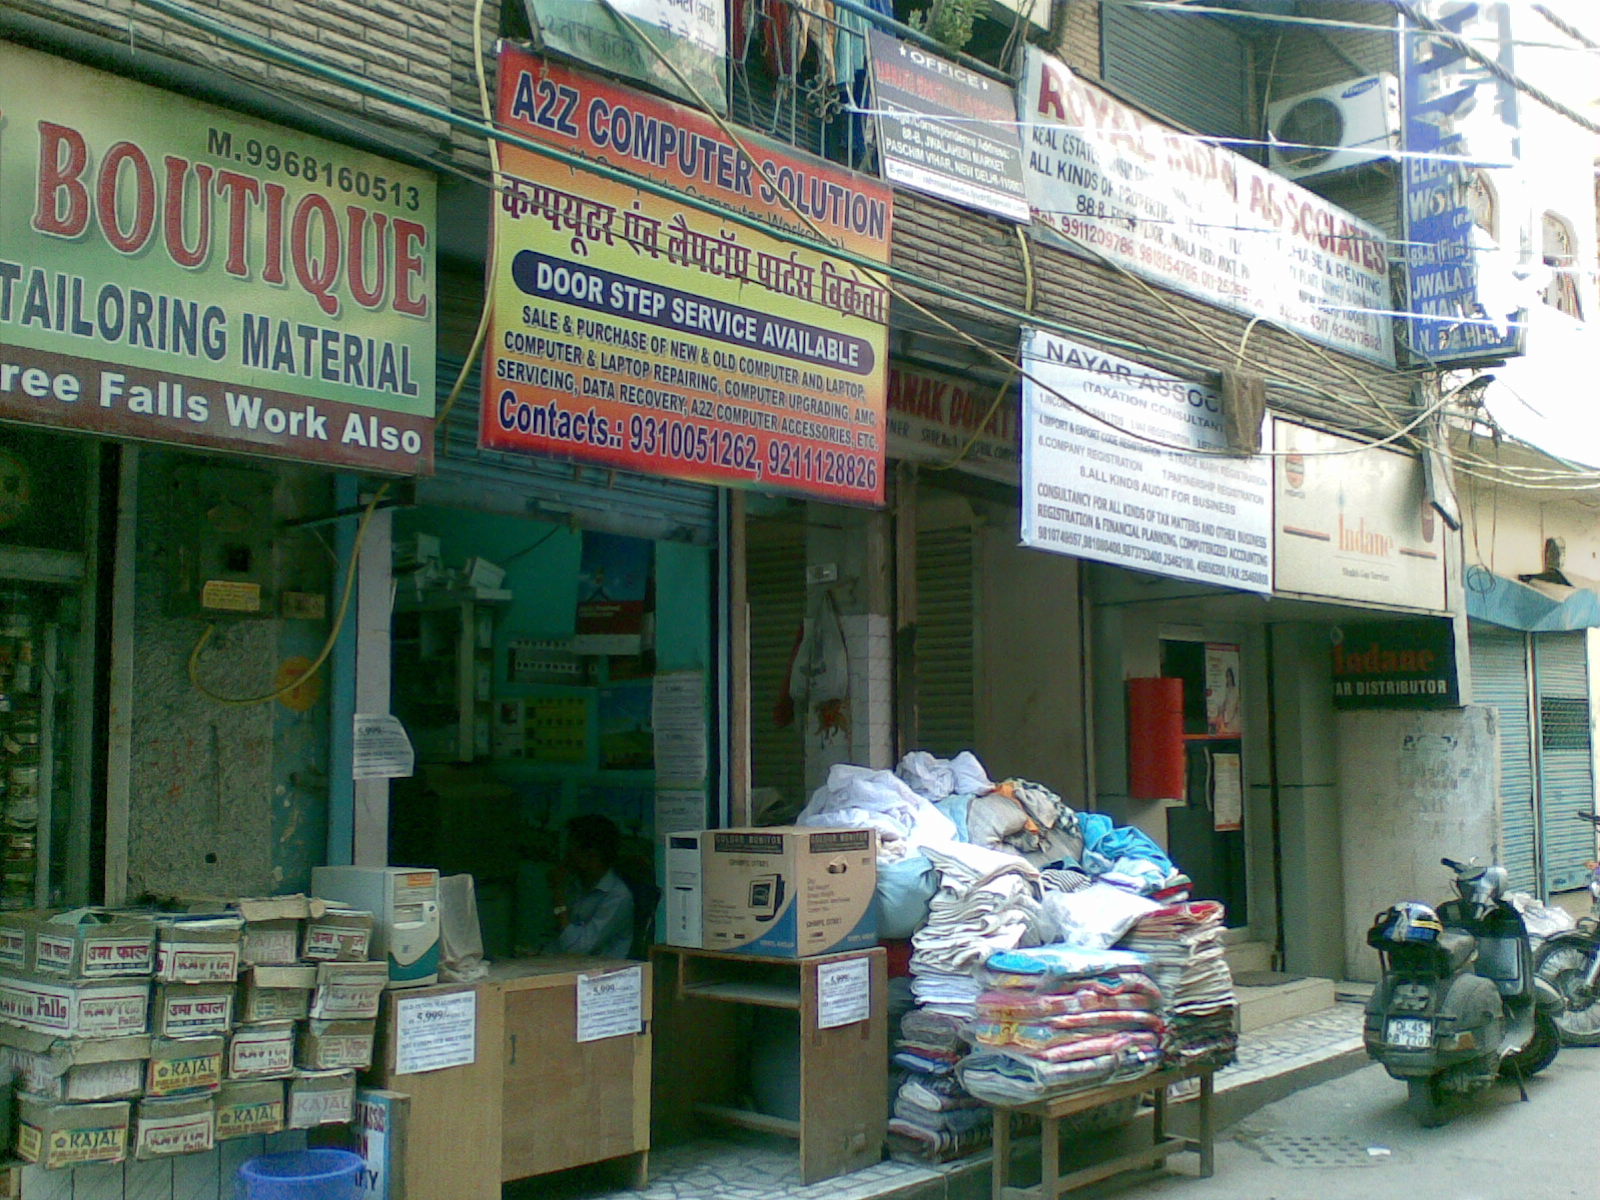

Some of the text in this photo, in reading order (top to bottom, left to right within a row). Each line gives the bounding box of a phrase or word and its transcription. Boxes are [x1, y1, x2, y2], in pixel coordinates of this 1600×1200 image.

[911, 51, 979, 89] OFFICE
[208, 127, 421, 211] M.9968160513
[511, 70, 579, 138] A2Z
[588, 97, 753, 197] COMPUTER
[760, 160, 886, 242] SOLUTION
[1030, 151, 1053, 177] ALL
[1058, 160, 1098, 191] KINDS
[32, 119, 429, 317] BOUTIQUE
[1336, 266, 1381, 296] RENTING
[1412, 267, 1462, 300] JWALA
[0, 261, 420, 397] TAILORING MATERIAL
[537, 262, 860, 368] DOOR STEP SERVICE AVAILABLE
[523, 305, 560, 331] SALE
[562, 314, 573, 335] &
[577, 318, 648, 351] PURCHASE
[651, 335, 667, 355] OF
[671, 340, 698, 362] NEW
[700, 347, 710, 365] &
[713, 350, 736, 371] OLD
[740, 356, 799, 386] COMPUTER
[802, 371, 823, 391] AND
[497, 358, 579, 397] SERVICING,
[583, 376, 615, 400] DATA
[620, 383, 689, 416] RECOVERY,
[691, 398, 714, 419] A2Z
[717, 404, 778, 432] COMPUTER
[504, 331, 583, 366] COMPUTER
[586, 349, 597, 368] &
[601, 352, 650, 379] LAPTOP
[654, 363, 722, 397] REPAIRING,
[725, 379, 786, 407] COMPUTER
[854, 408, 876, 426] AMC
[1047, 340, 1223, 414] NAYAR ASSOC
[1083, 381, 1148, 410] (TAXATION
[0, 362, 422, 455] ree Falls Work Also
[630, 414, 764, 481] 9310051262,
[769, 440, 877, 492] 9211128826
[1087, 445, 1143, 473] REGISTRATION
[1038, 482, 1092, 508] CONSULTANCY
[1093, 495, 1108, 511] FOR
[1109, 499, 1121, 514] ALL
[1156, 511, 1169, 526] TAX
[1038, 503, 1094, 529] REGISTRATION
[1110, 471, 1140, 492] KINDS
[1142, 482, 1169, 499] AUDIT
[1171, 489, 1190, 505] FOR
[1192, 495, 1236, 516] BUSINESS
[1338, 513, 1394, 558] Indane
[1356, 679, 1448, 697] DISTRIBUTOR
[171, 1057, 214, 1076] KAJAL
[233, 1105, 277, 1121] KAJAL
[71, 1131, 117, 1149] KAJAL
